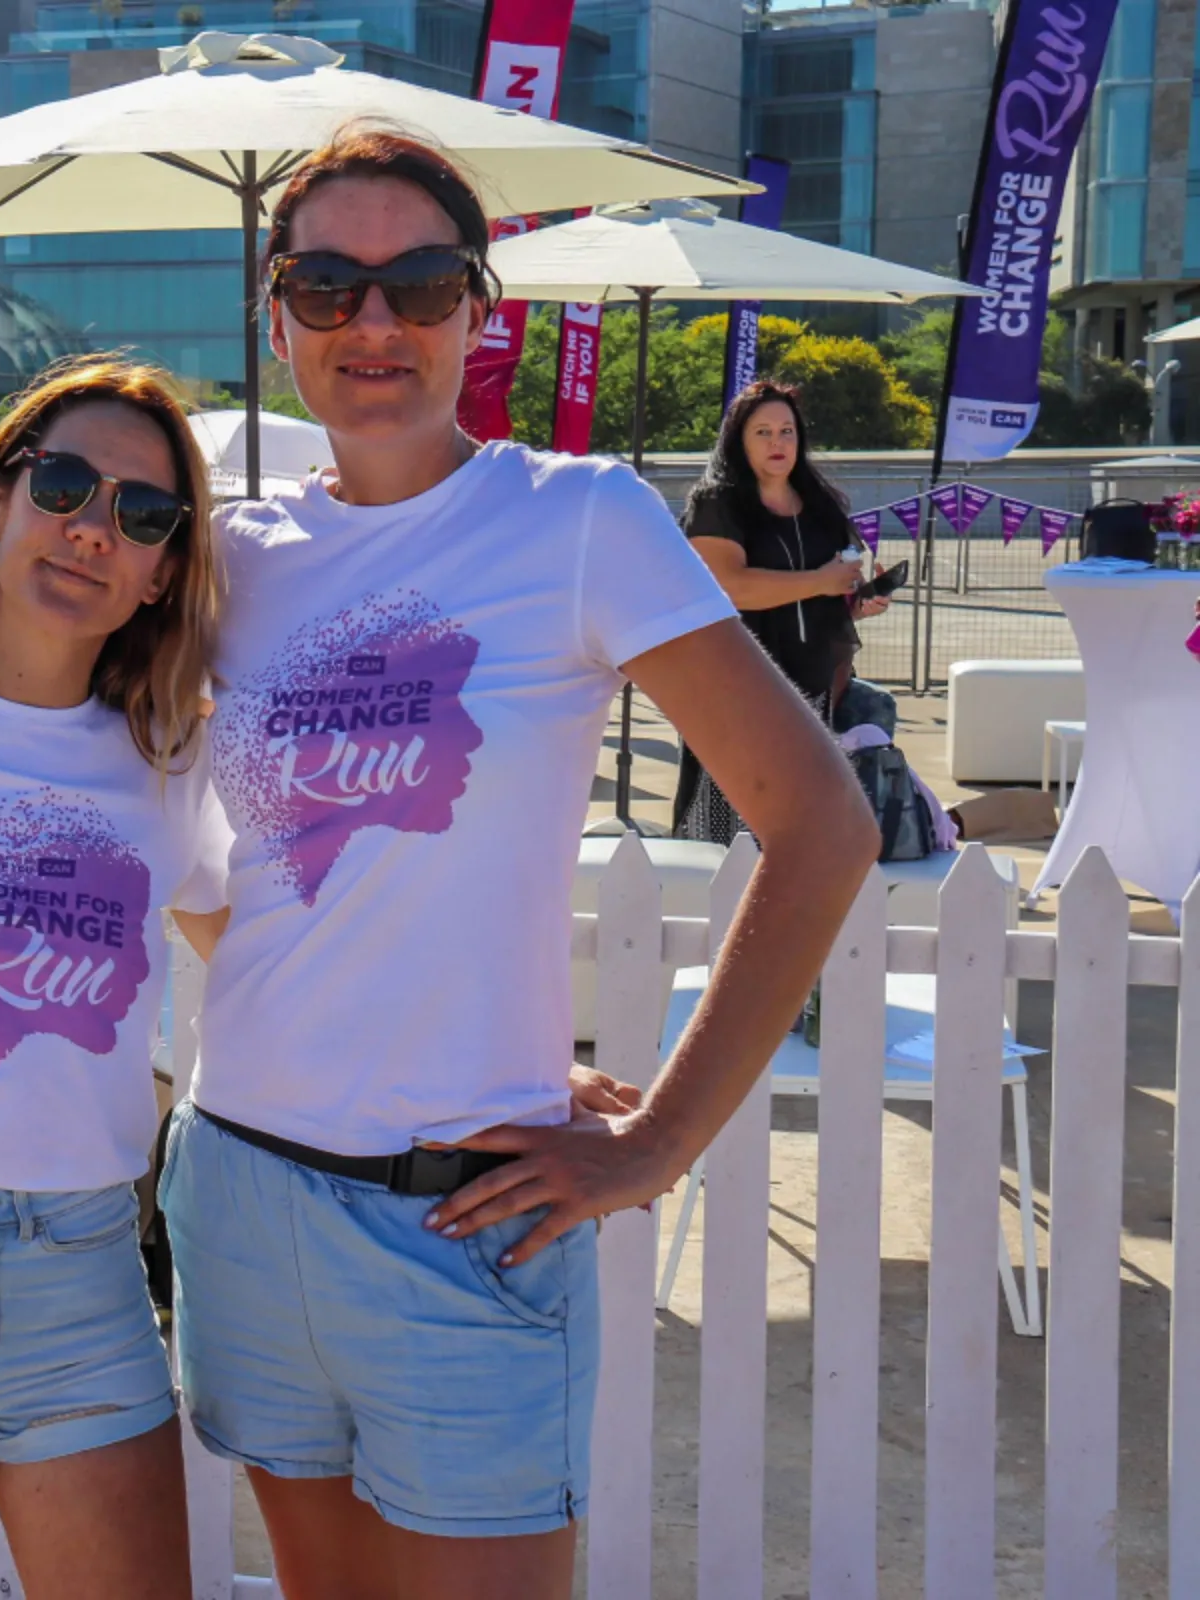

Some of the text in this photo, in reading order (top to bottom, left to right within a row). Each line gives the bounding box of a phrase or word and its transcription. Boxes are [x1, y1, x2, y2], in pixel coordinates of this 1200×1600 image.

[995, 3, 1087, 164] Run
[977, 171, 1021, 334] WOMEN FOR
[1000, 173, 1052, 337] CHANGE
[480, 313, 512, 350] IF
[741, 311, 757, 387] HANGE
[561, 352, 576, 399] CATCH
[575, 333, 593, 405] IF YOU
[995, 413, 1022, 426] CAN
[352, 660, 381, 672] CAN
[272, 680, 434, 707] WOMEN FOR
[266, 698, 431, 738] CHANGE
[267, 731, 430, 806] Run
[42, 862, 71, 874] CAN
[76, 893, 125, 918] FOR
